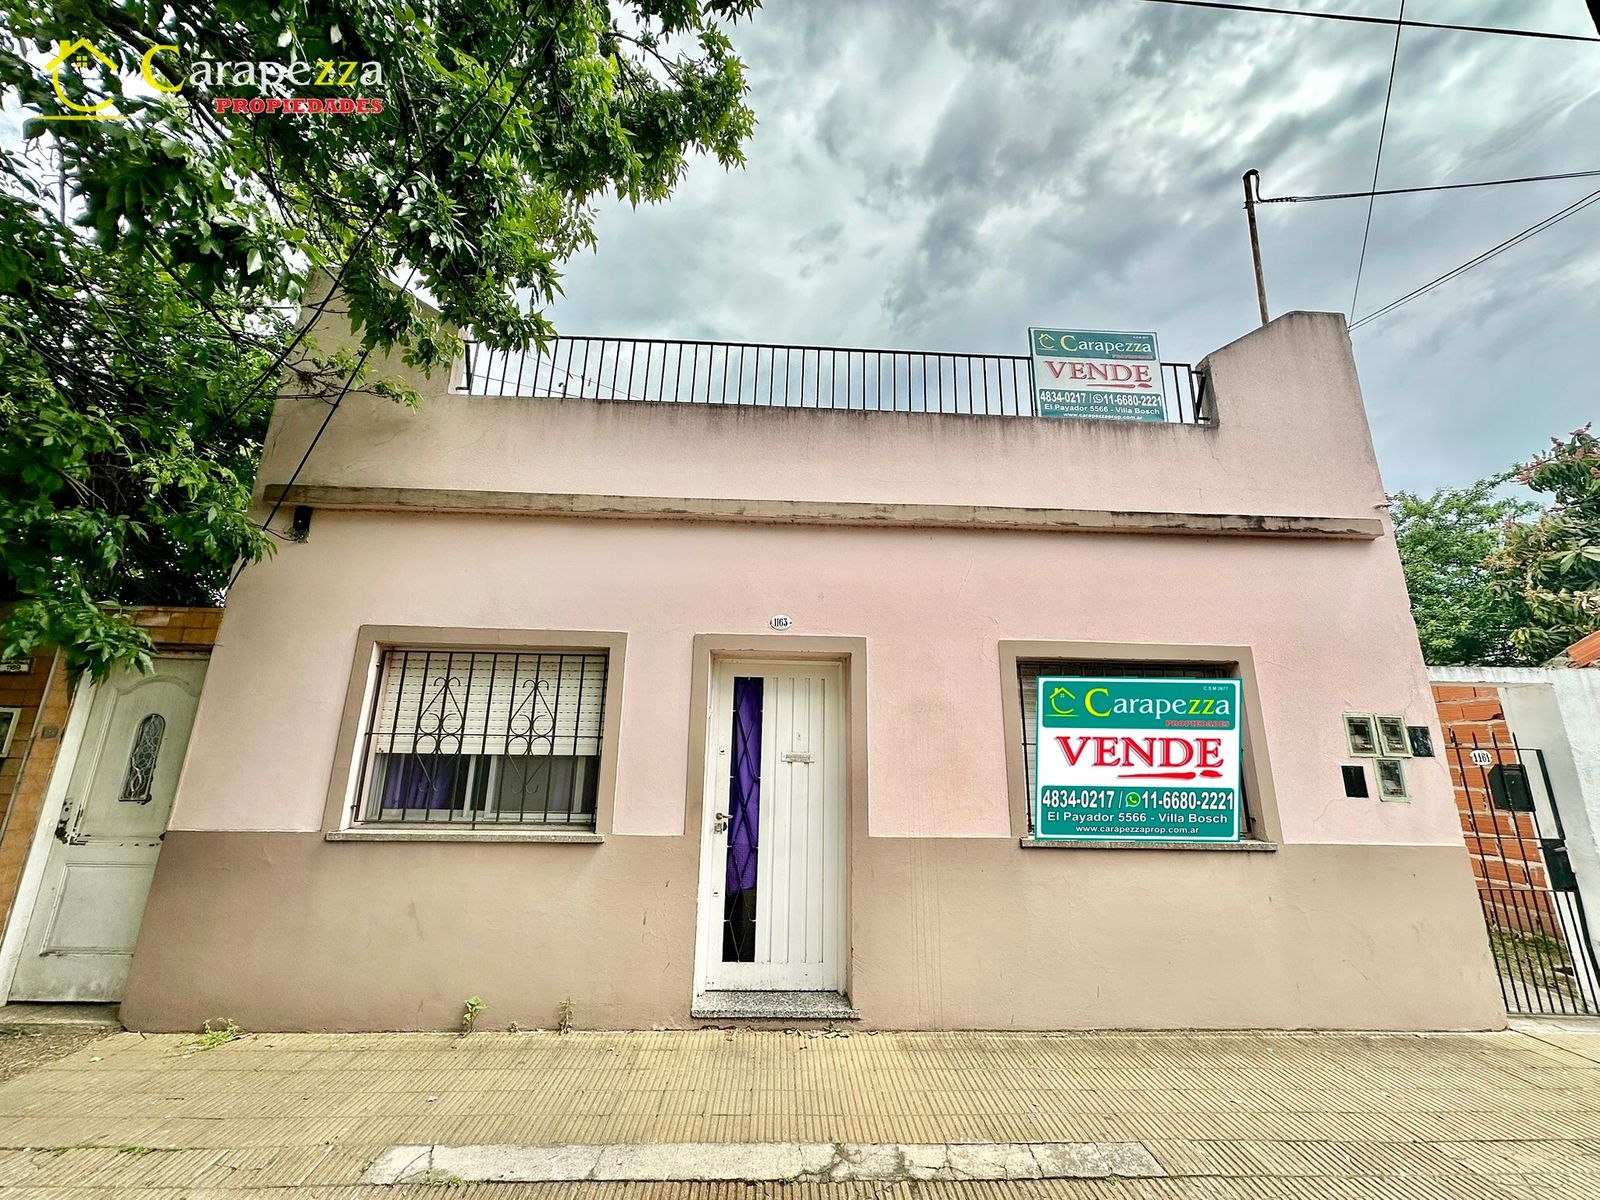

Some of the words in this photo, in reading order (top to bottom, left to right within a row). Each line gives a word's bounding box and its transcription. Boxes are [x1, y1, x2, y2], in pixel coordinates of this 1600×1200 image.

[1060, 335, 1152, 354] Carapezza
[1045, 360, 1152, 382] VENDE
[1040, 391, 1086, 403] 4834-0217
[1104, 394, 1162, 407] 11-6680-2221
[1055, 404, 1088, 412] Payador
[1115, 406, 1133, 414] Villa
[1134, 407, 1160, 415] Bosch
[774, 618, 788, 627] 1163
[1084, 688, 1230, 719] Carapezza
[1055, 736, 1224, 768] VENDE
[1473, 753, 1490, 762] 1161
[1042, 789, 1115, 808] 4834-0217
[1142, 791, 1234, 810] 11-6680-2221
[1048, 812, 1060, 821] El
[1064, 813, 1115, 823] Payador
[1118, 813, 1147, 822] 5566
[1158, 813, 1185, 823] Villa
[1188, 814, 1228, 823] Bosch
[1076, 825, 1200, 834] www.carapezzaprop.com.ar
